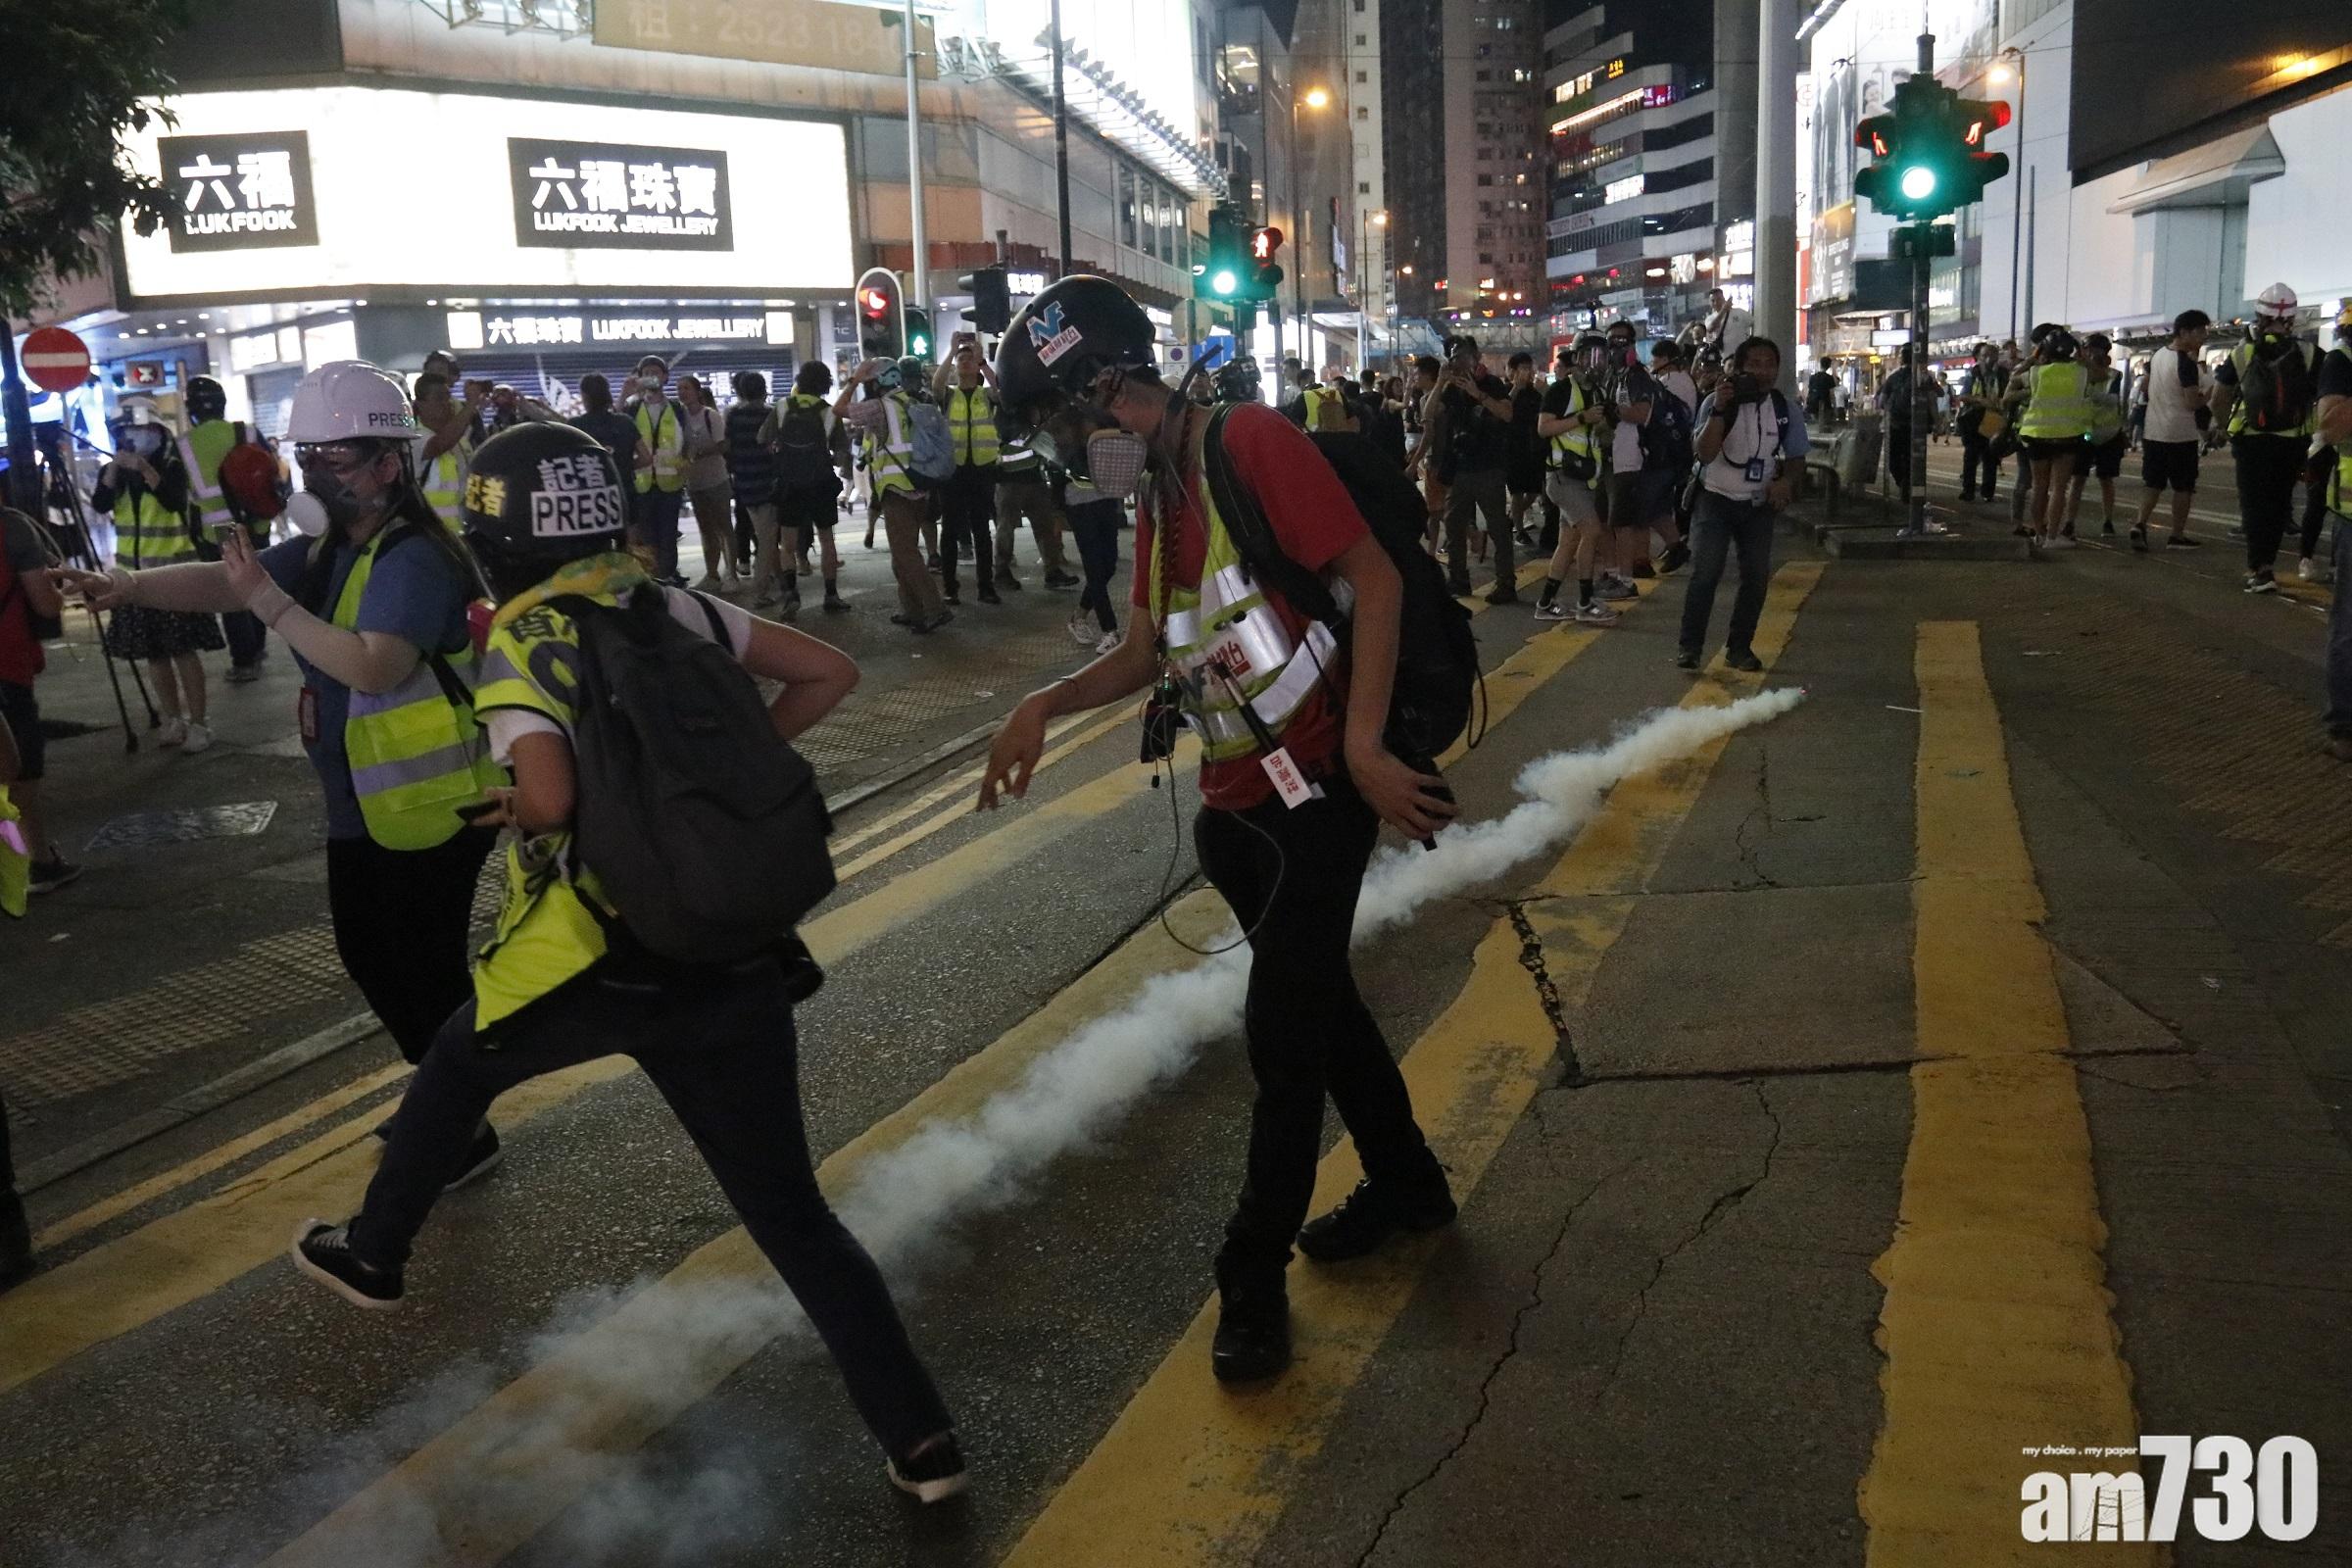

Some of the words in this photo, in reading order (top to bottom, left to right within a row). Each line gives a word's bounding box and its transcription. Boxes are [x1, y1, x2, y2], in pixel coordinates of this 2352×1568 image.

[179, 151, 295, 212] 六福
[529, 157, 716, 216] 六福珠寶
[534, 212, 618, 233] LUKFOOK
[620, 215, 718, 235] JEWELLERY
[488, 317, 582, 343] 六福珠寶
[672, 318, 764, 338] JEWELLERY
[368, 412, 417, 427] PRESS
[538, 455, 606, 491] 記者
[466, 472, 506, 517] 記者
[536, 490, 620, 532] PRESS
